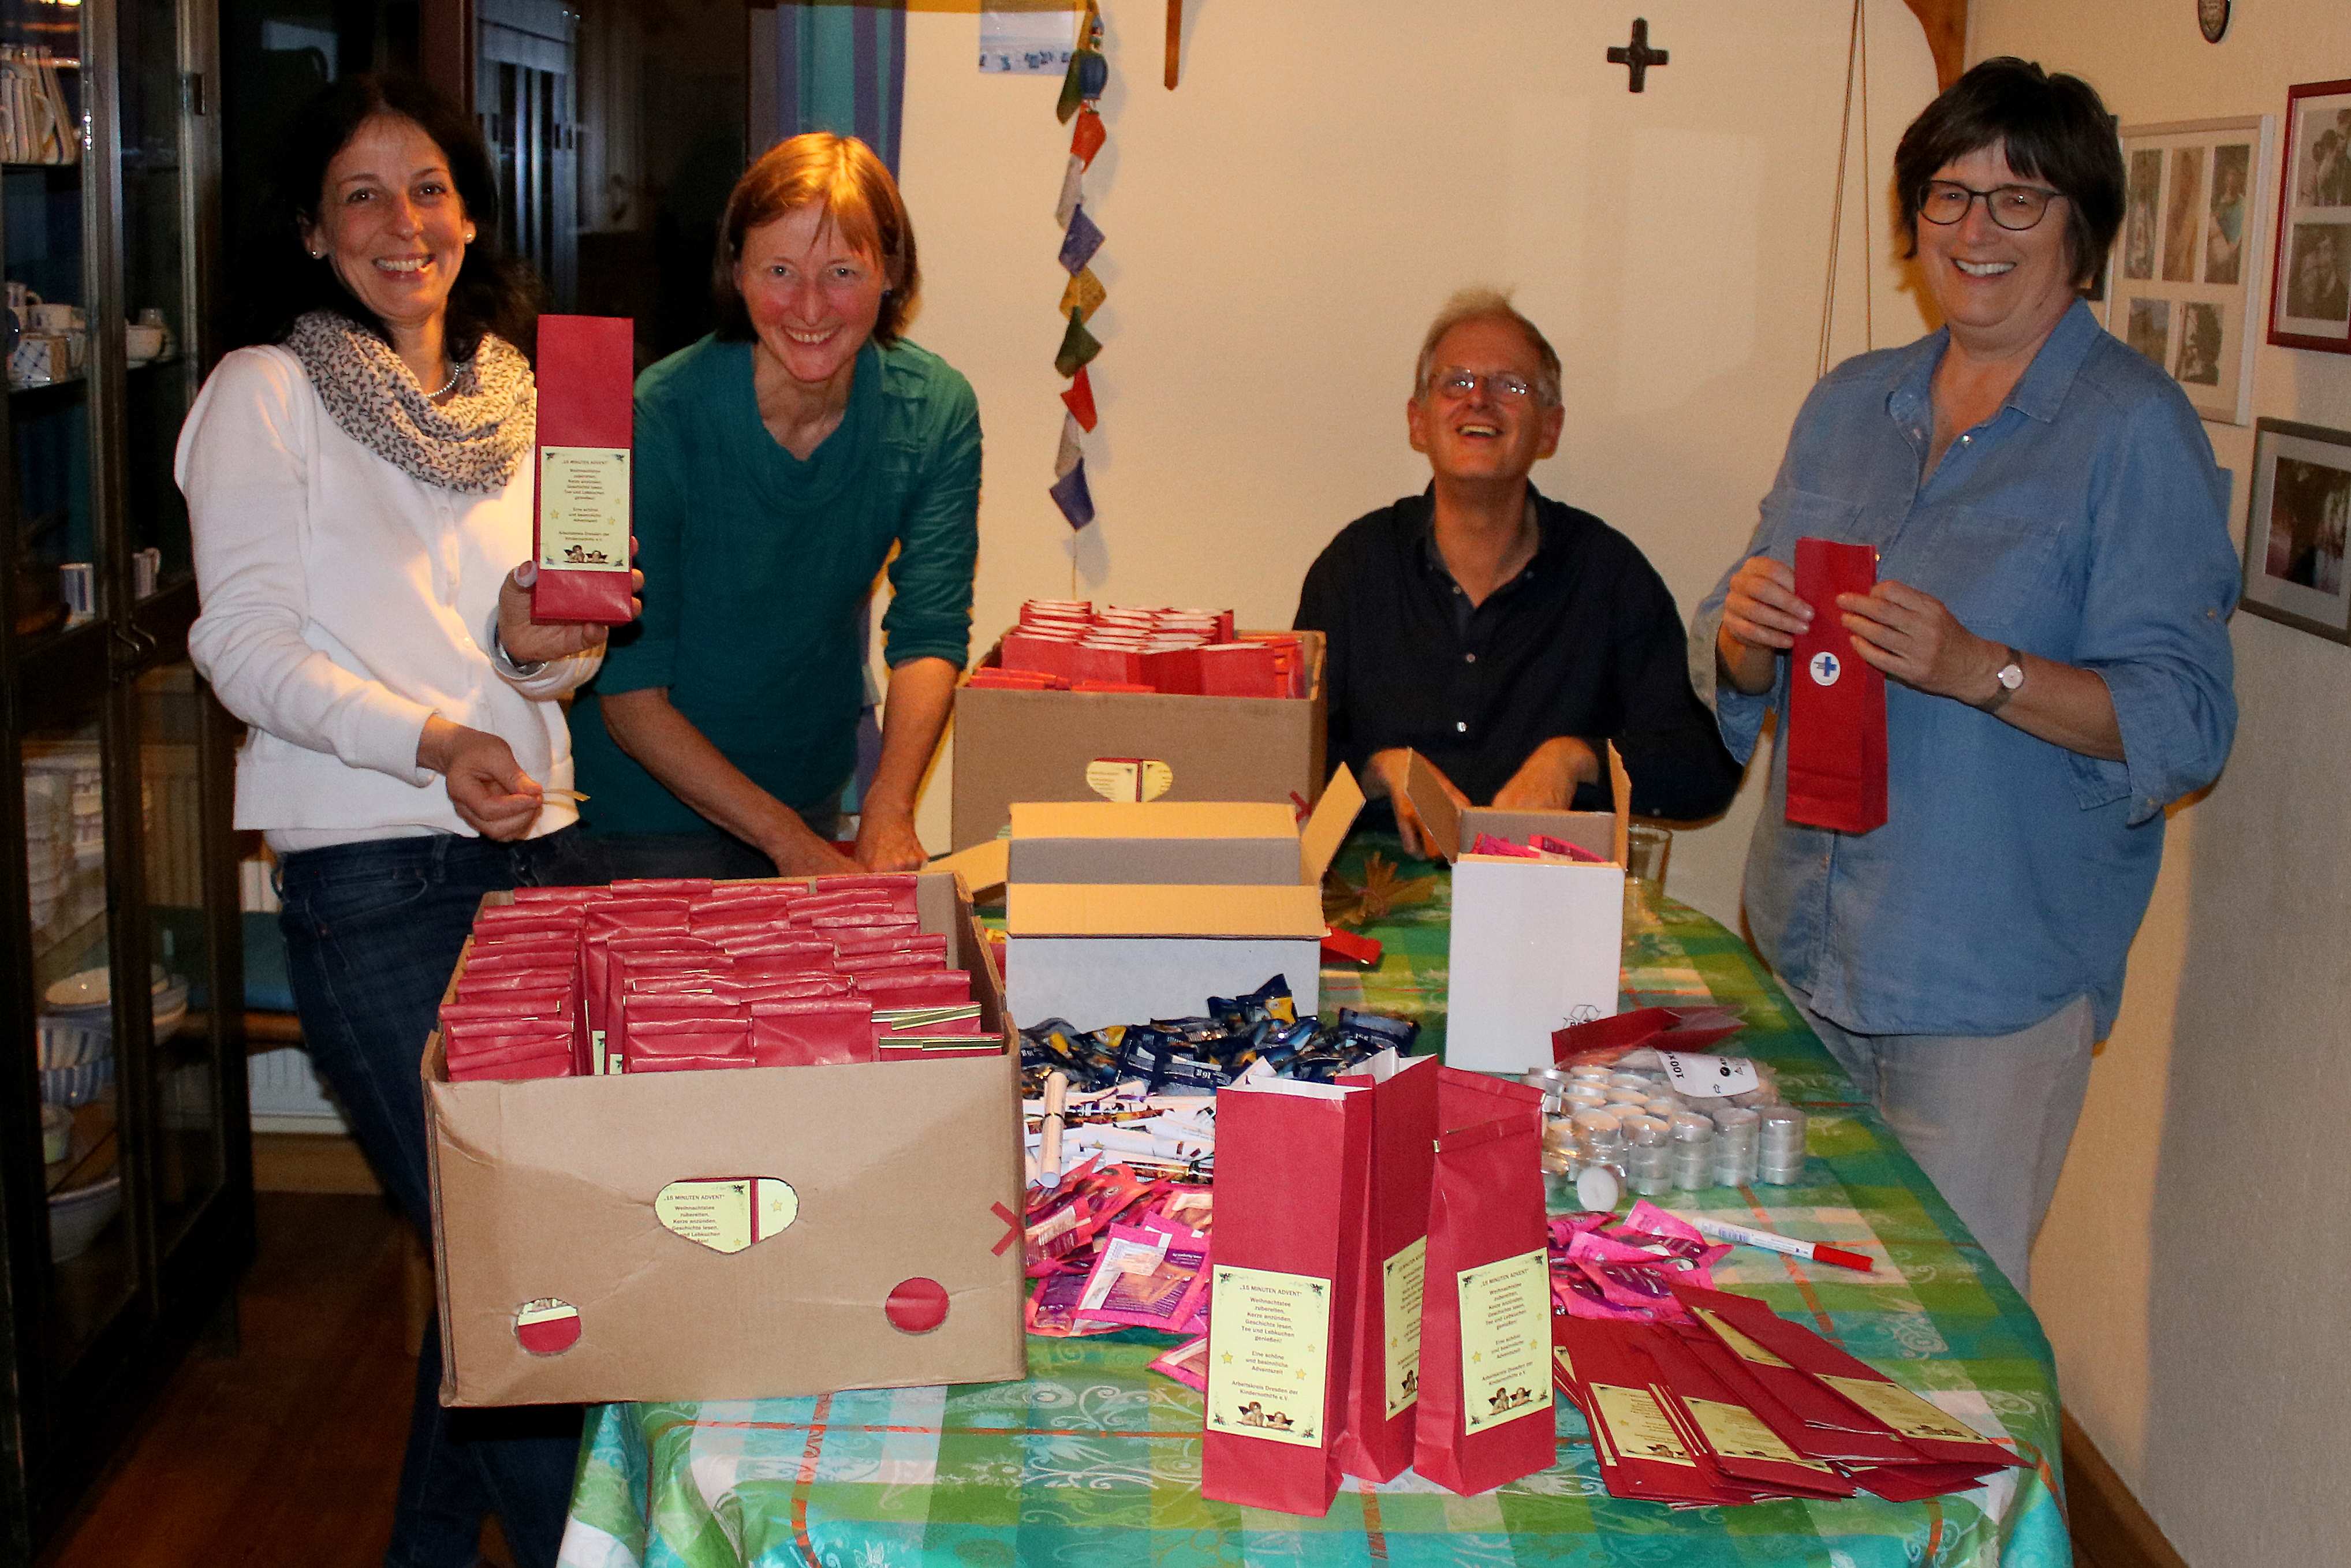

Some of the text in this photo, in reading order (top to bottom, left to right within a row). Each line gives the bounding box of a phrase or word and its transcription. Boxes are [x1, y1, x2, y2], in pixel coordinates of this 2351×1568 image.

[1251, 1286, 1277, 1294] MINUTEN
[1250, 1297, 1292, 1307] Weihnachtstee
[1245, 1319, 1275, 1327] Geschichte
[1264, 1329, 1294, 1337] Lebkuchen
[1257, 1359, 1289, 1368] besinnliche
[1265, 1386, 1288, 1394] Dresden
